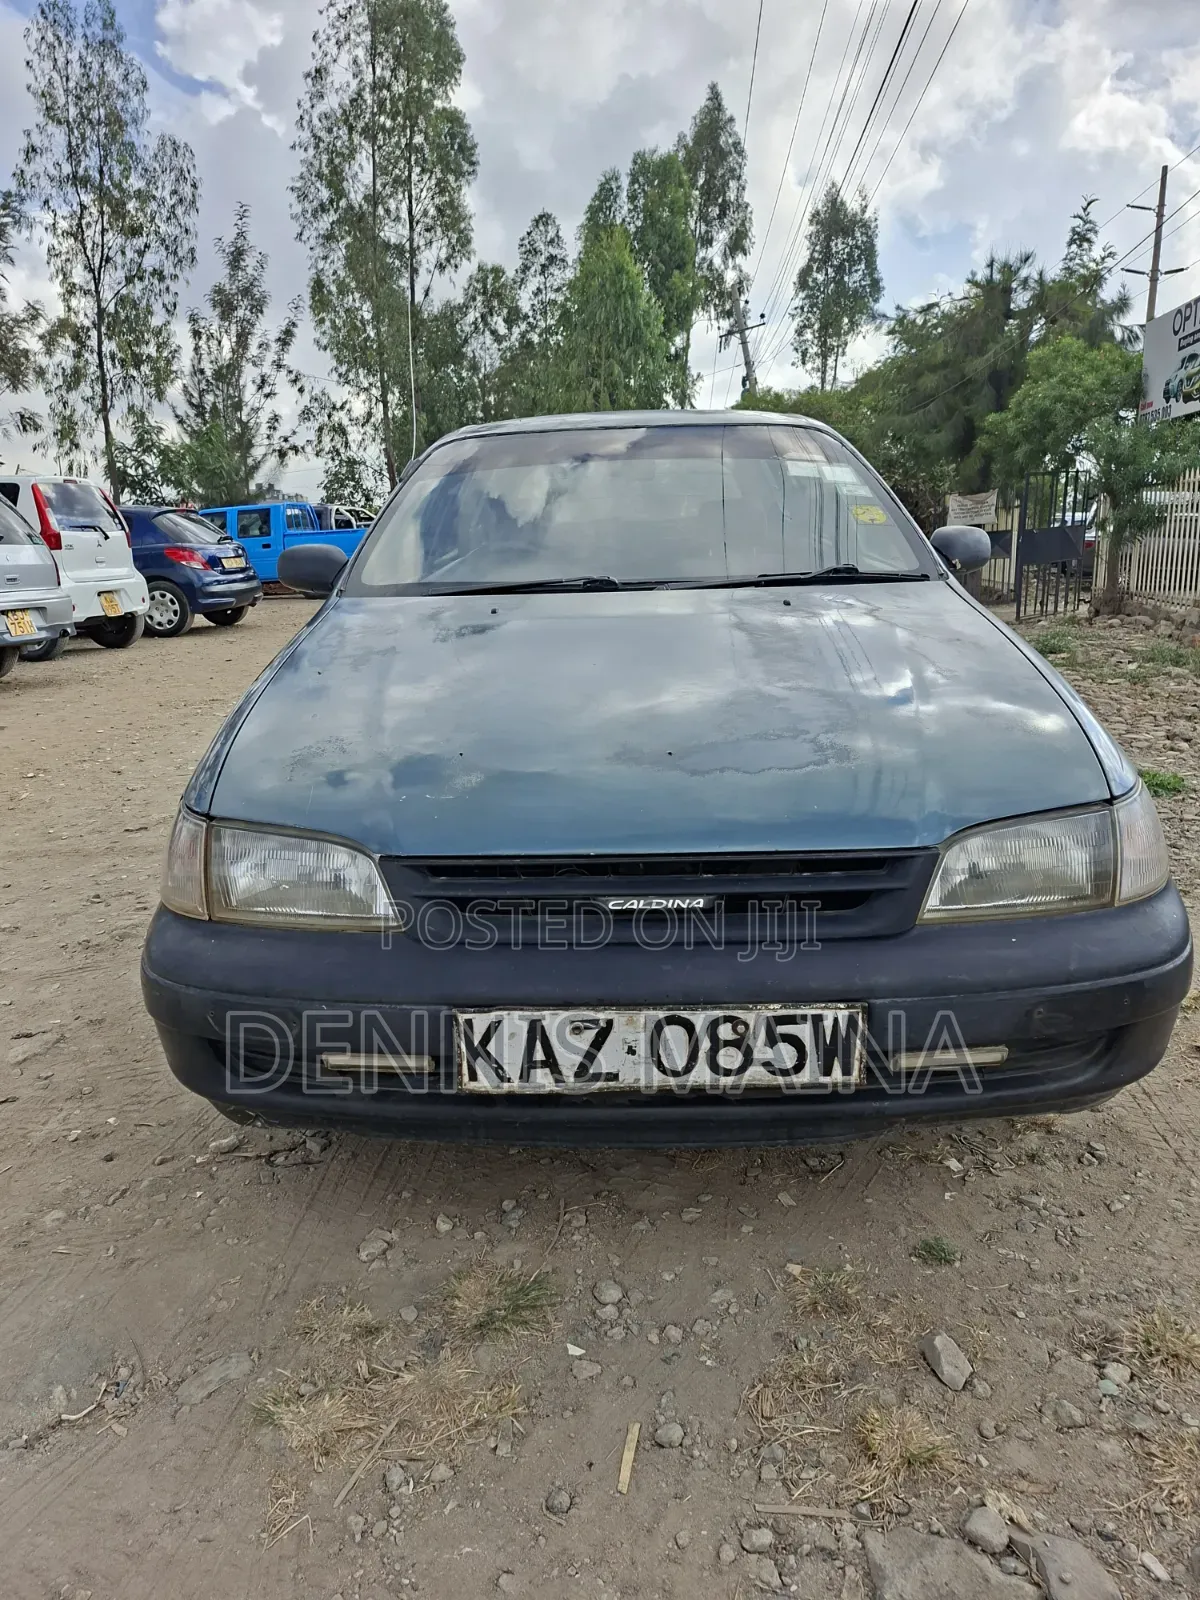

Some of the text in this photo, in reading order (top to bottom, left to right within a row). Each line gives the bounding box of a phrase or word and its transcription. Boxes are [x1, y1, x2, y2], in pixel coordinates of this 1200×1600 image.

[1172, 296, 1200, 336] OPT
[608, 898, 704, 910] CALDINA
[463, 1013, 861, 1084] KAZ 085W
